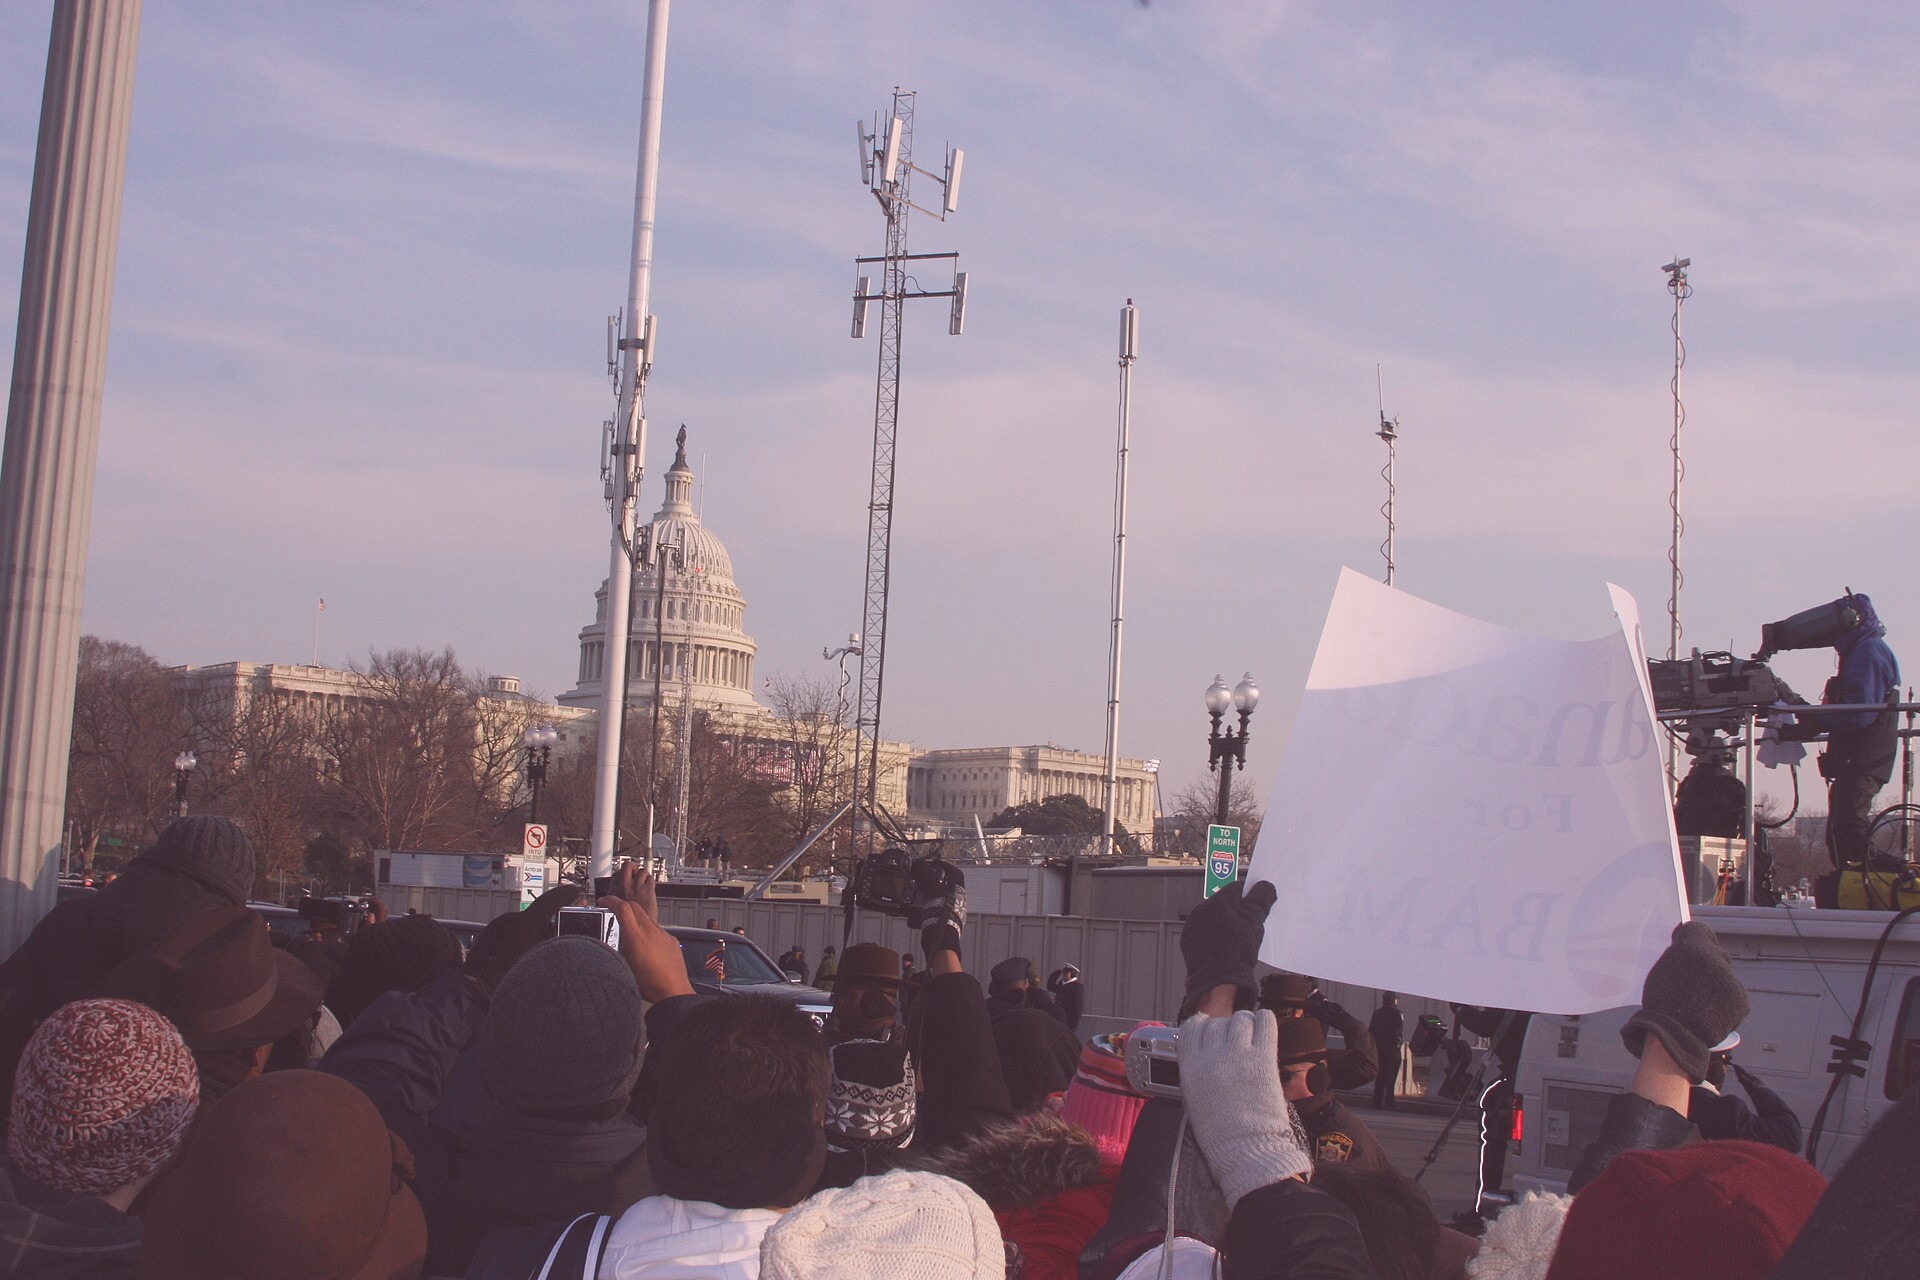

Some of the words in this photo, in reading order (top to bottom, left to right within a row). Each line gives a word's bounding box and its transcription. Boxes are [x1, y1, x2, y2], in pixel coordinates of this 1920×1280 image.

[1220, 829, 1230, 837] TO
[1213, 837, 1236, 847] NORTH
[524, 865, 542, 873] Amtrak
[1215, 862, 1229, 874] 95
[1319, 1134, 1351, 1145] SHERIFF
